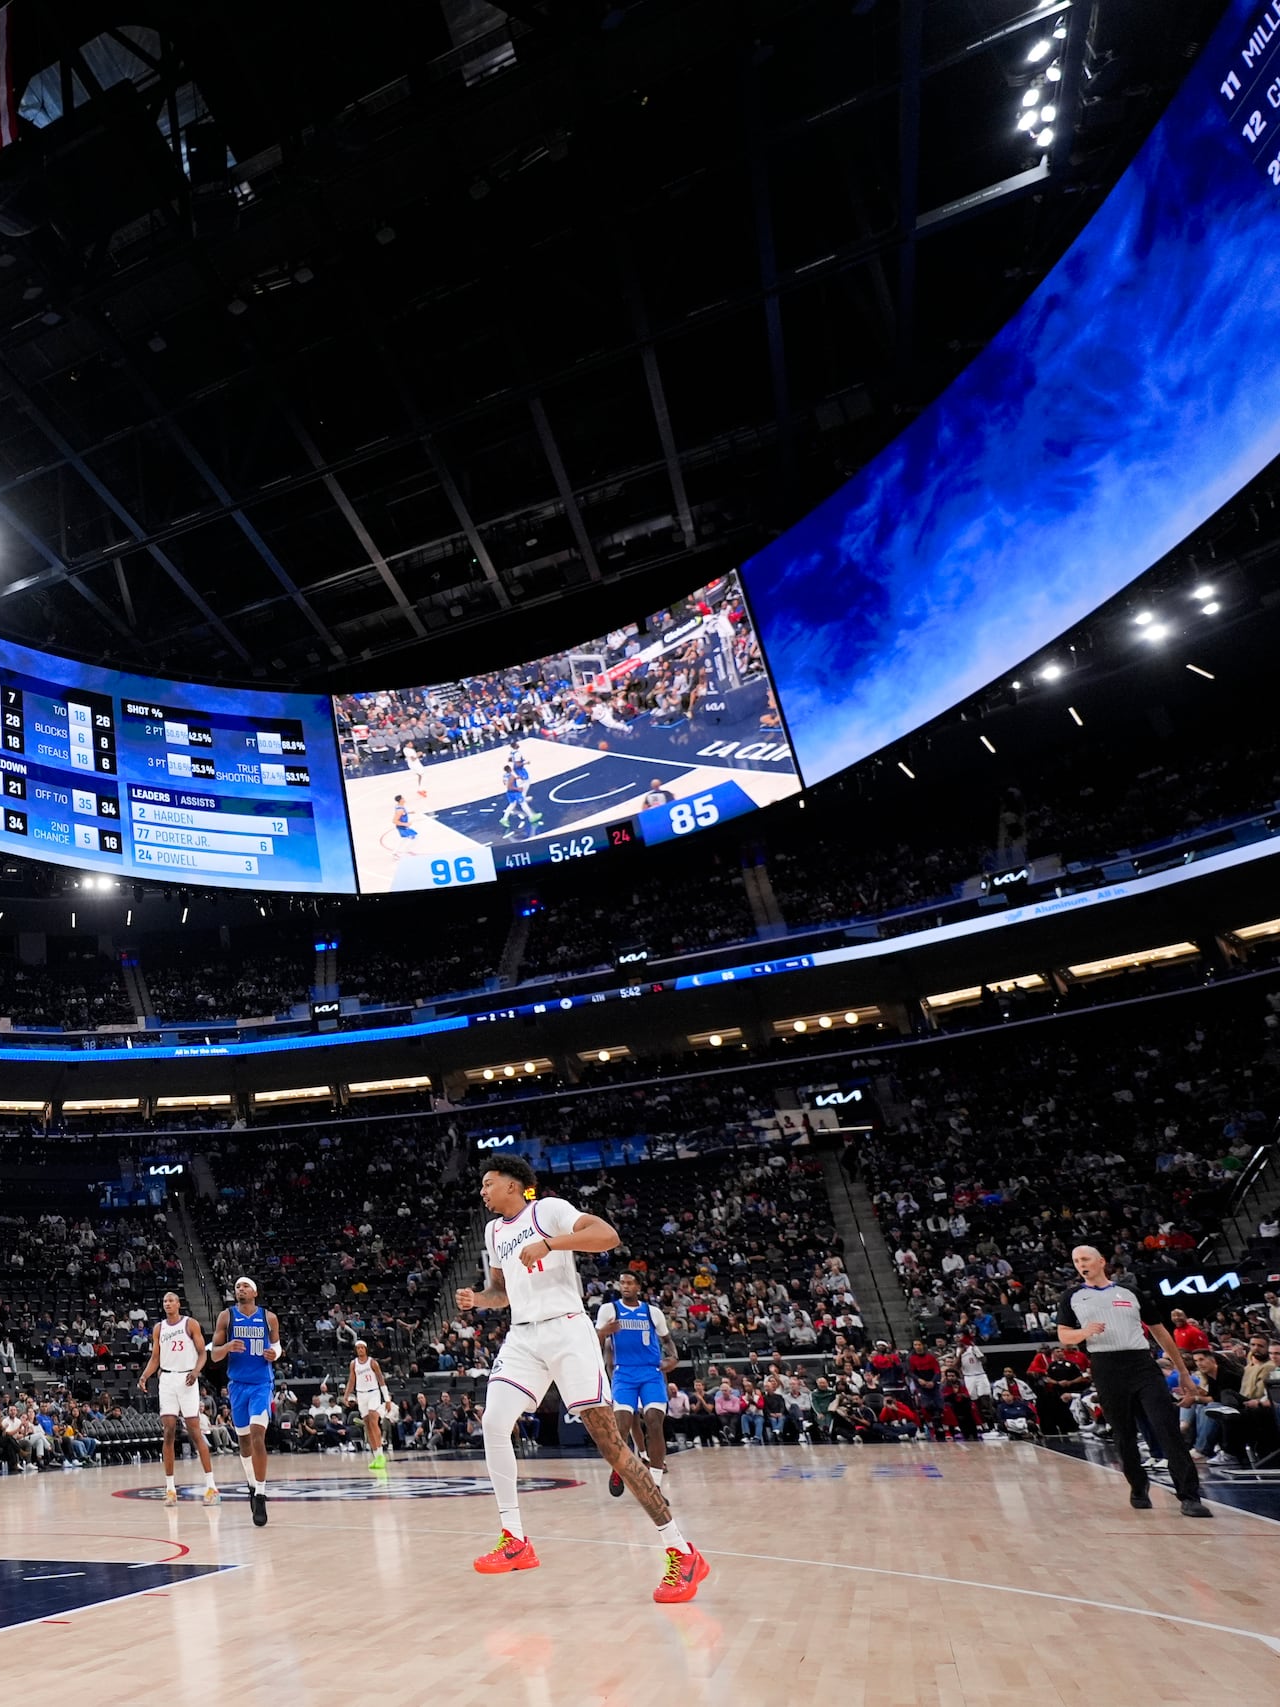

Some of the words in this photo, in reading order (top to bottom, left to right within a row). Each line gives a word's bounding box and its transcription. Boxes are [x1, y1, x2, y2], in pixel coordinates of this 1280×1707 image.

[1220, 70, 1242, 100] 11
[1242, 110, 1267, 143] 12
[52, 704, 67, 717] T/O
[74, 710, 86, 722] 18
[95, 714, 111, 728] 26
[126, 703, 150, 716] SHOT
[151, 708, 163, 719] %
[5, 713, 20, 728] 28
[34, 722, 68, 739] BLOCKS
[145, 725, 152, 735] 2
[152, 726, 164, 736] PT
[7, 735, 20, 749] 18
[245, 738, 256, 747] FT
[696, 741, 741, 757] LA
[37, 743, 69, 760] STEALS
[76, 753, 89, 765] 18
[147, 757, 154, 767] 3
[155, 758, 167, 769] PT
[236, 763, 260, 775] TRUE
[215, 771, 261, 784] SHOOTING
[9, 780, 22, 795] 21
[35, 788, 52, 800] OFF
[52, 792, 68, 805] T/O
[78, 797, 93, 810] 35
[101, 801, 117, 816] 34
[131, 788, 171, 803] LEADERS
[180, 795, 216, 809] ASSISTS
[8, 815, 24, 831] 34
[50, 821, 70, 834] 2ND
[153, 810, 194, 825] HARDEN
[271, 822, 284, 833] 12
[33, 828, 70, 845] CHANCE
[104, 836, 118, 850] 16
[137, 827, 150, 840] 77
[155, 830, 194, 845] PORTER
[194, 835, 210, 847] JR.
[430, 856, 476, 886] 96
[505, 851, 531, 868] 4TH
[548, 835, 597, 863] 5:42
[612, 829, 631, 845] 24
[669, 793, 719, 835] 85
[138, 849, 153, 861] 24
[157, 851, 198, 867] POWELL
[620, 986, 641, 998] 5:42
[497, 1226, 535, 1260] Clippers
[171, 1341, 184, 1351] 23
[250, 1339, 264, 1355] 10
